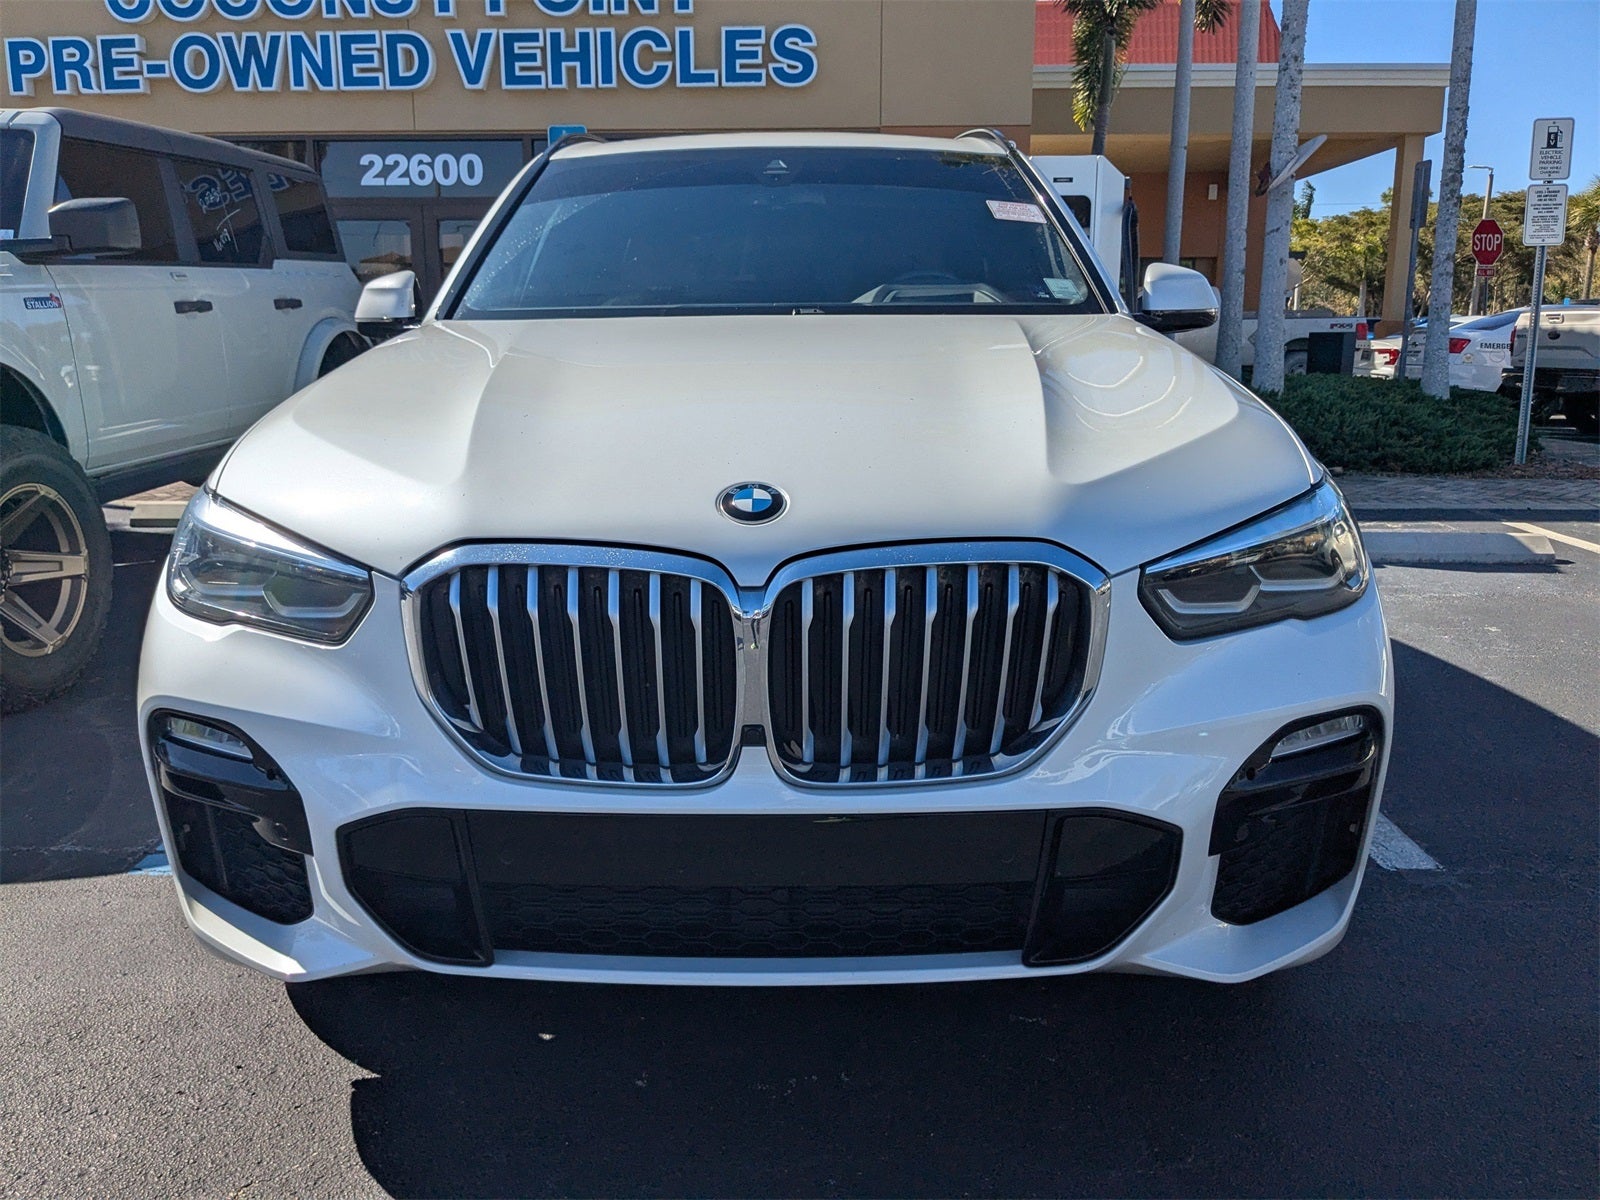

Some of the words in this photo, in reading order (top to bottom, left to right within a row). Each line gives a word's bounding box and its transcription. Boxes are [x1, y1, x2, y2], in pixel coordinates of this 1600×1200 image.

[5, 30, 436, 96] PRE-OWNED
[445, 24, 818, 91] VEHICLES
[359, 152, 485, 187] 22600
[1473, 233, 1502, 252] STOP
[26, 300, 59, 309] STALLION
[728, 483, 780, 496] BMW
